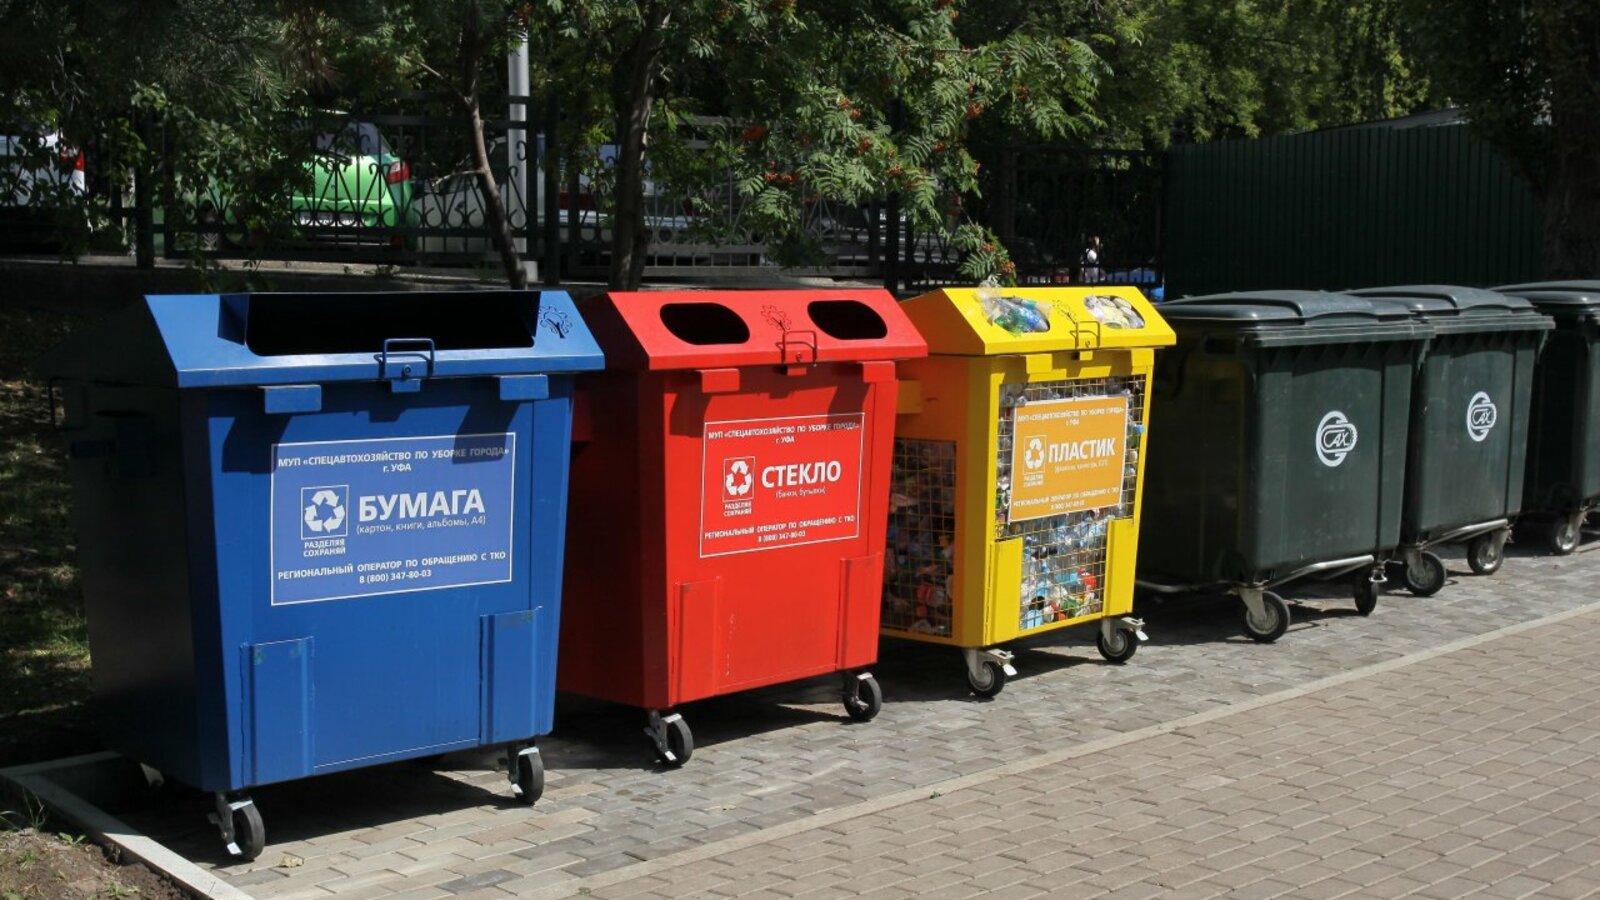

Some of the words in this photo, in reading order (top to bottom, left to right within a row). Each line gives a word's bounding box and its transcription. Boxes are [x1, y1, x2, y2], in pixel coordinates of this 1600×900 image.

[797, 425, 806, 433] ПО
[278, 458, 301, 467] МУП
[303, 451, 411, 465] «СПЕЦАВТОХОЗЯЙСТВО
[415, 451, 429, 460] ПО
[432, 448, 467, 459] УБОРКЕ
[1048, 438, 1115, 463] ПЛАСТИК
[391, 463, 412, 472] УФА
[761, 460, 841, 488] СТЕКЛО
[359, 489, 486, 521] БУМАГА
[356, 522, 394, 535] (картон,
[396, 521, 425, 532] книги,
[427, 516, 470, 529] альбомы,
[303, 547, 346, 557] СОХРАНЯЙ
[304, 539, 345, 549] РАЗДЕЛЯЯ
[278, 563, 354, 580] РЕГИОНАЛЬНЫЙ
[357, 560, 402, 572] ОПЕРАТОР
[405, 559, 418, 568] ПО
[421, 554, 478, 567] ОБРАЩЕНИЮ
[490, 551, 506, 560] ТКО
[367, 573, 389, 584] (800)
[391, 569, 432, 580] 347-80-03
